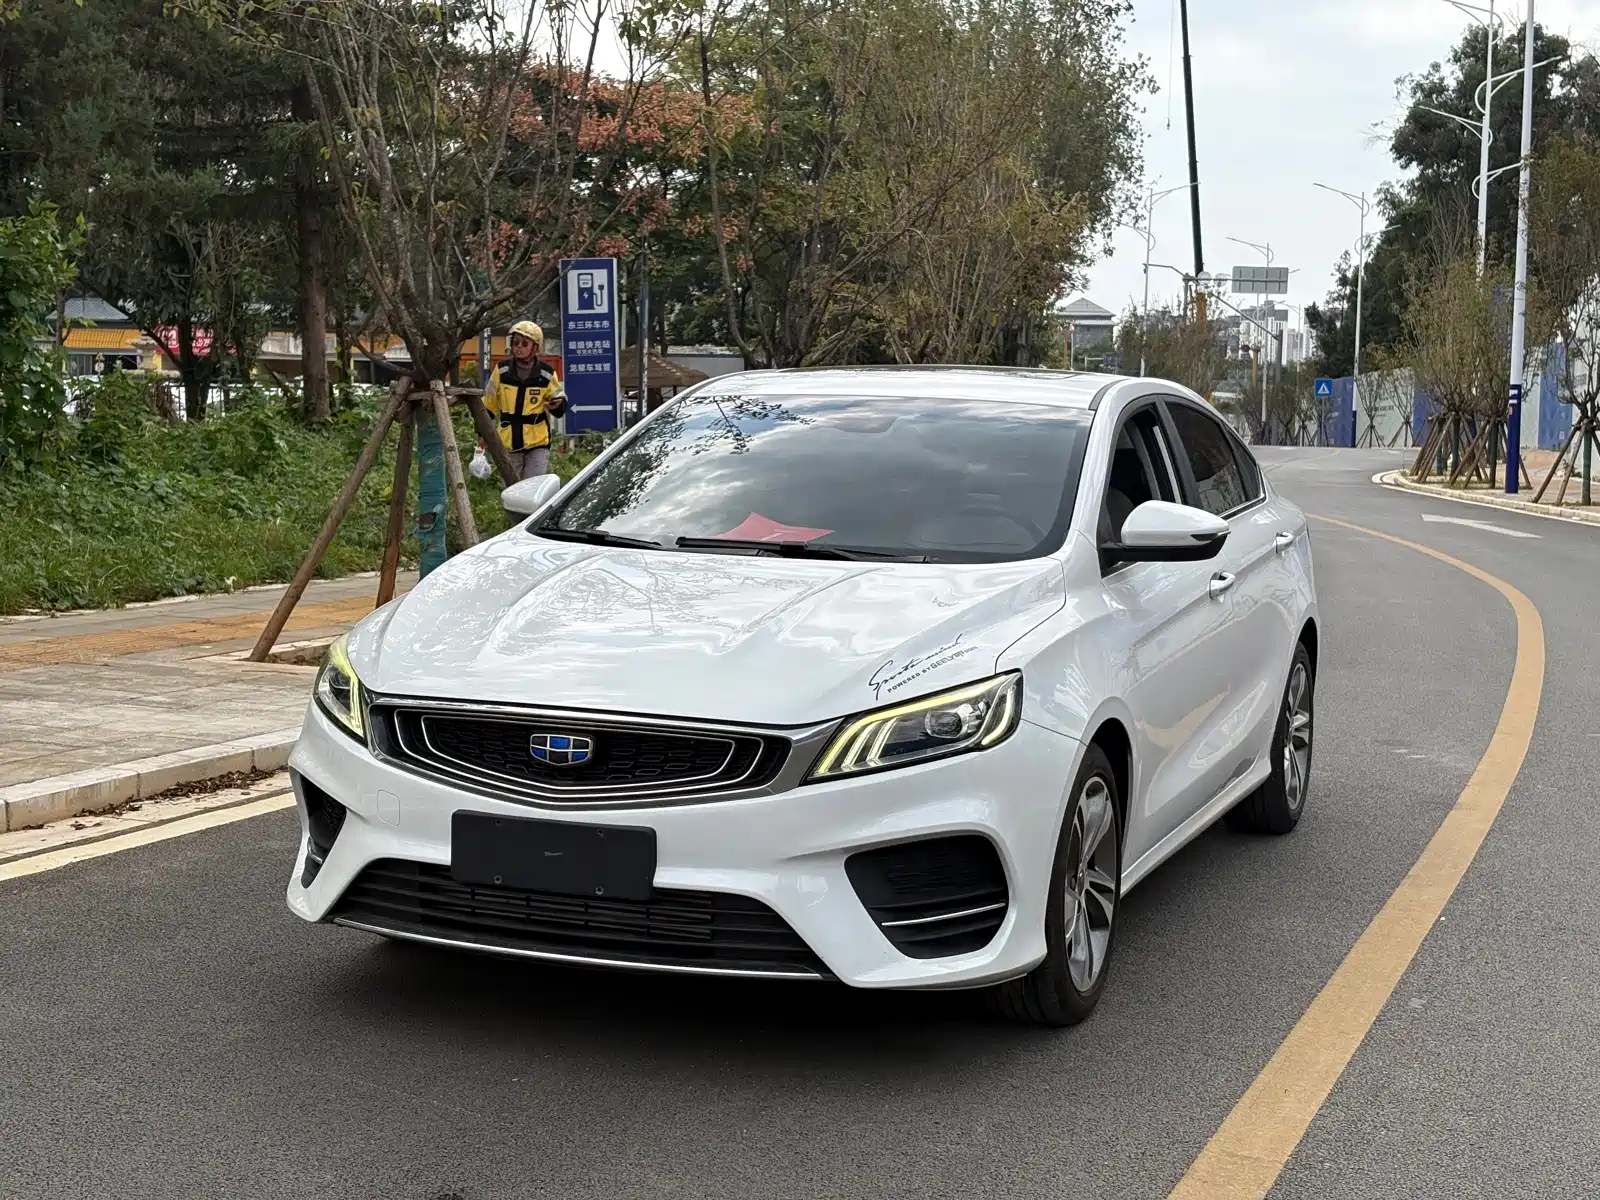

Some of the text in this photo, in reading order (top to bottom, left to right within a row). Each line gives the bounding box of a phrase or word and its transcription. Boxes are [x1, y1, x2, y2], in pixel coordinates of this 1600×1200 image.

[568, 320, 610, 329] 东三环车市
[568, 340, 611, 349] 超级快充站
[887, 672, 921, 693] POWERED
